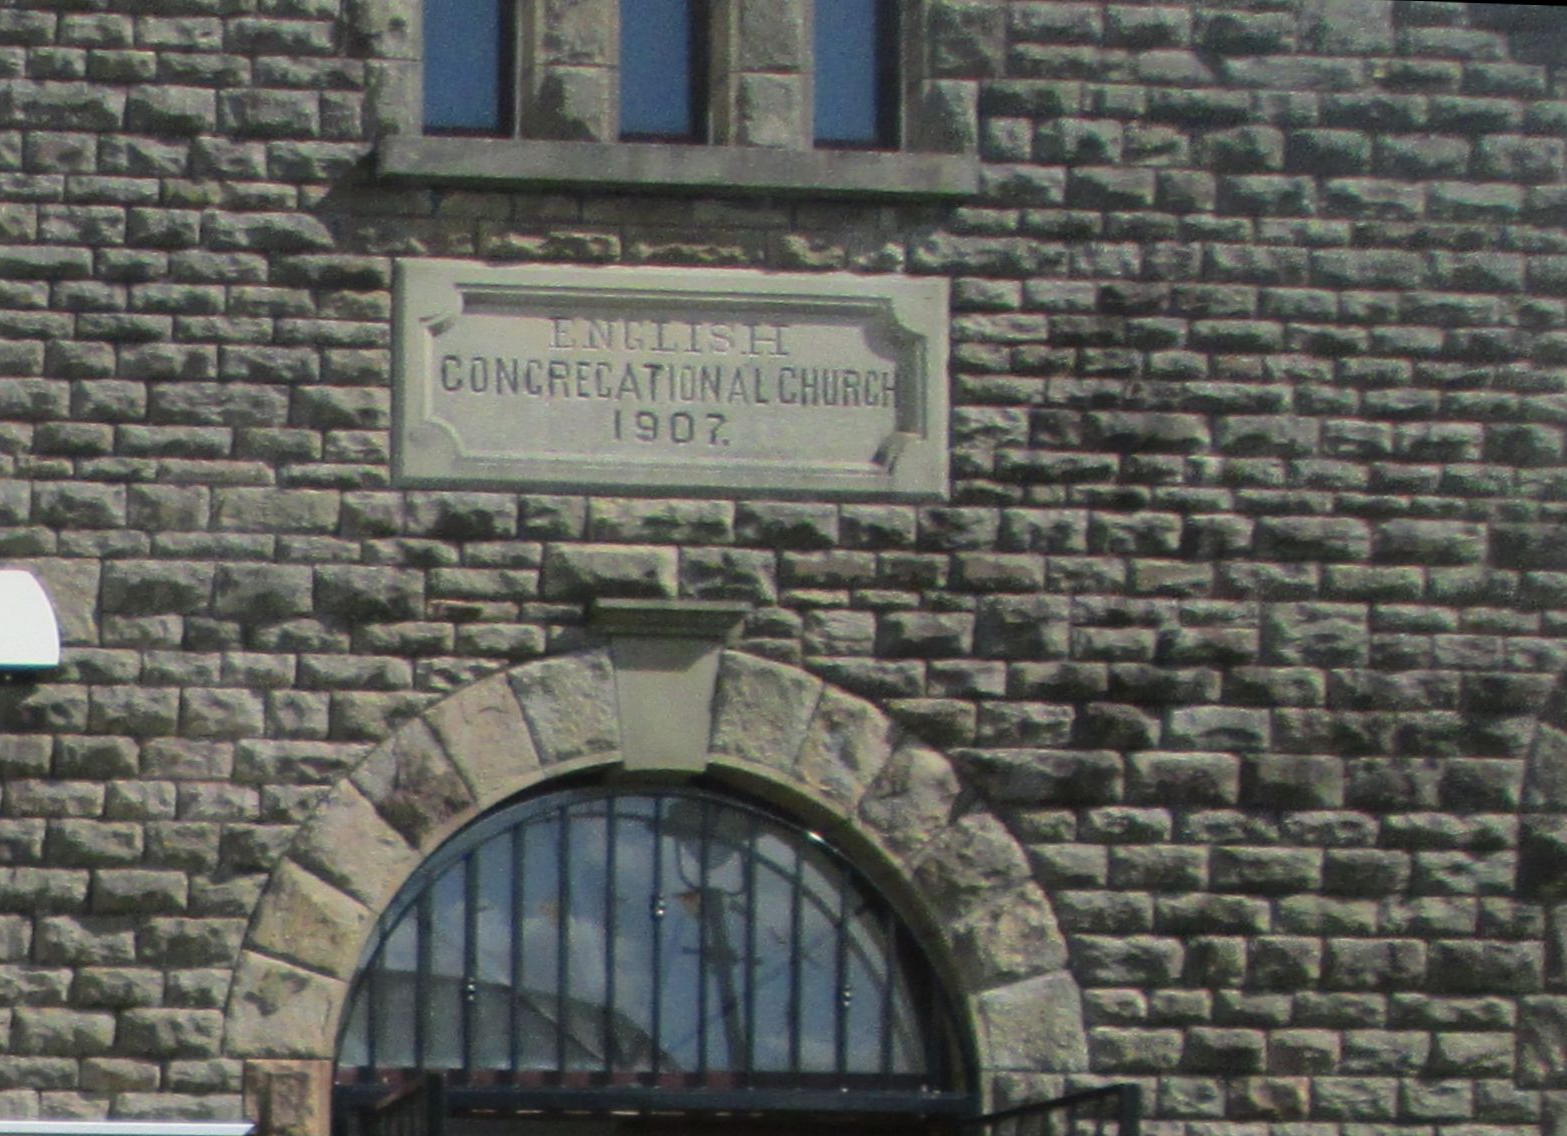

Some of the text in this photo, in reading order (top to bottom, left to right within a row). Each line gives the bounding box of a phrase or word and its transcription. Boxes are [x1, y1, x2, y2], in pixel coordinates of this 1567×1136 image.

[548, 316, 791, 357] ENGLISH
[440, 354, 897, 409] CONGREGATIONAL CHURCH
